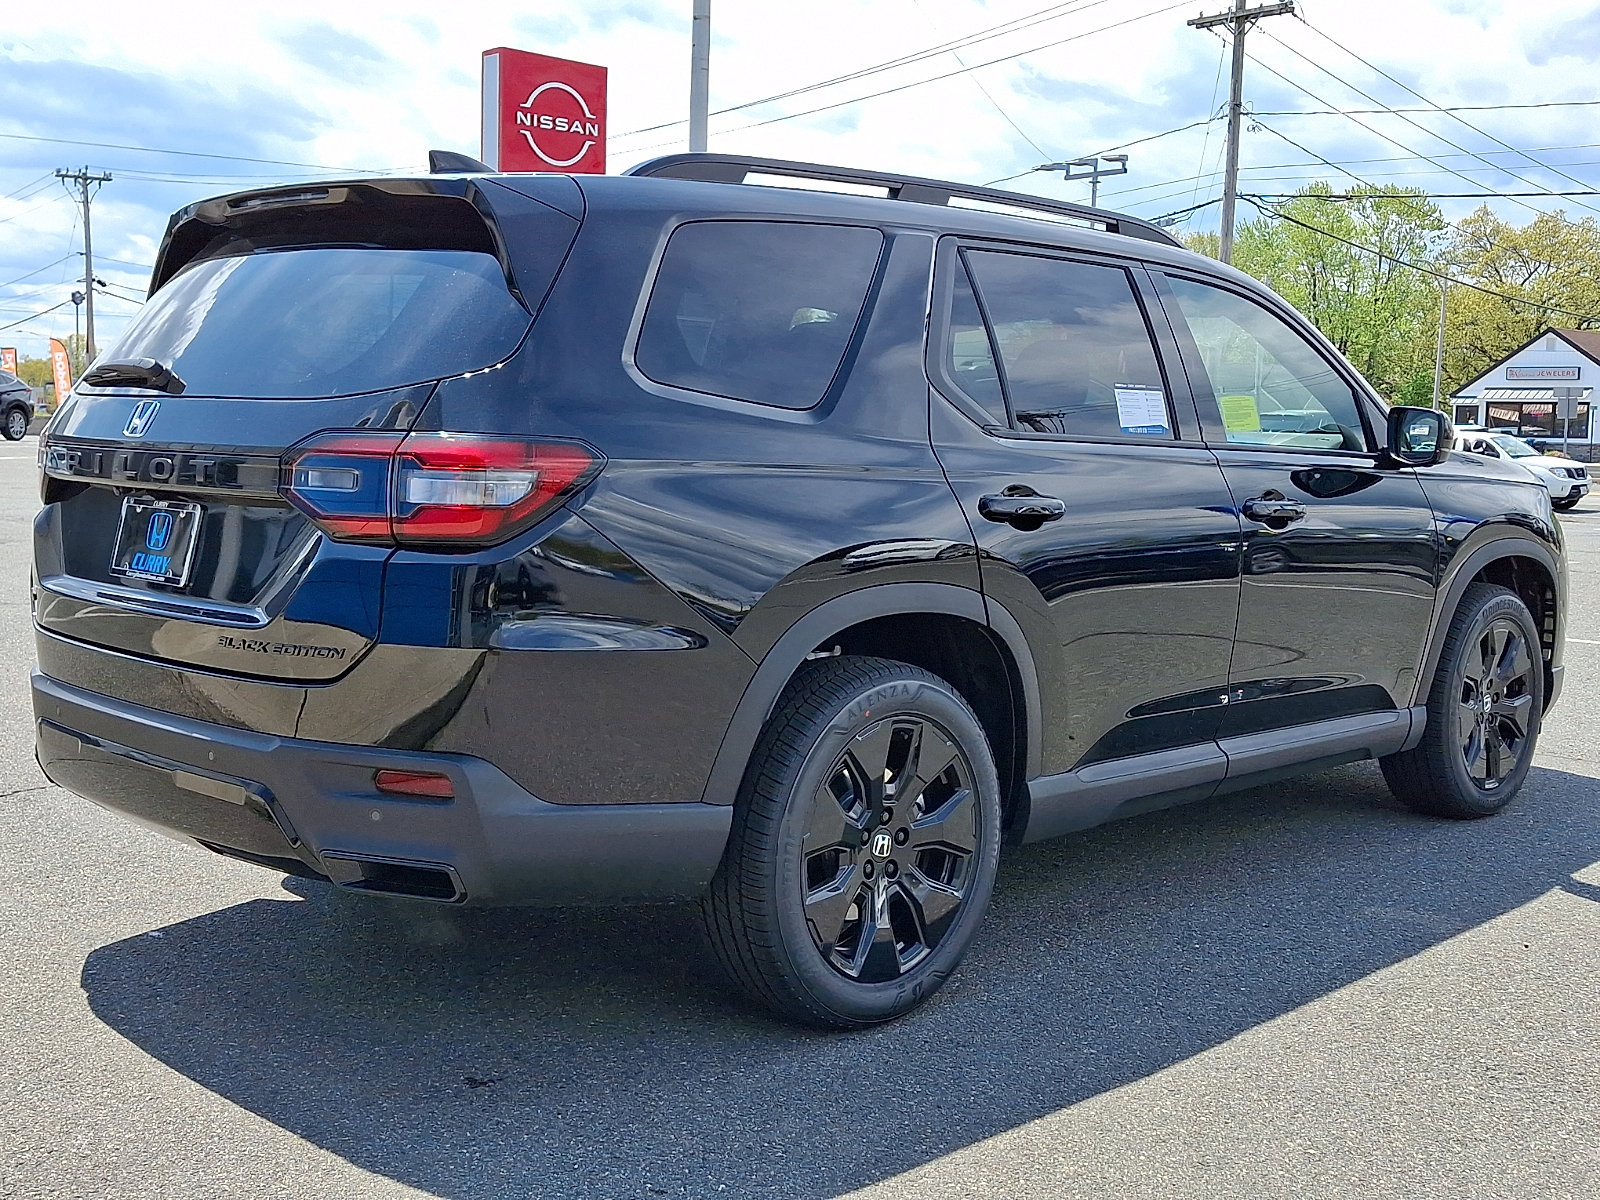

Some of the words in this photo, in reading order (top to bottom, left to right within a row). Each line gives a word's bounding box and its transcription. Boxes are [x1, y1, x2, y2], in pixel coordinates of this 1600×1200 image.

[516, 111, 599, 137] NISSAN
[68, 452, 214, 481] PILOT
[132, 553, 171, 573] CURRY
[218, 636, 270, 653] BLACK
[271, 642, 346, 660] EDITION
[847, 683, 910, 721] ALENZA
